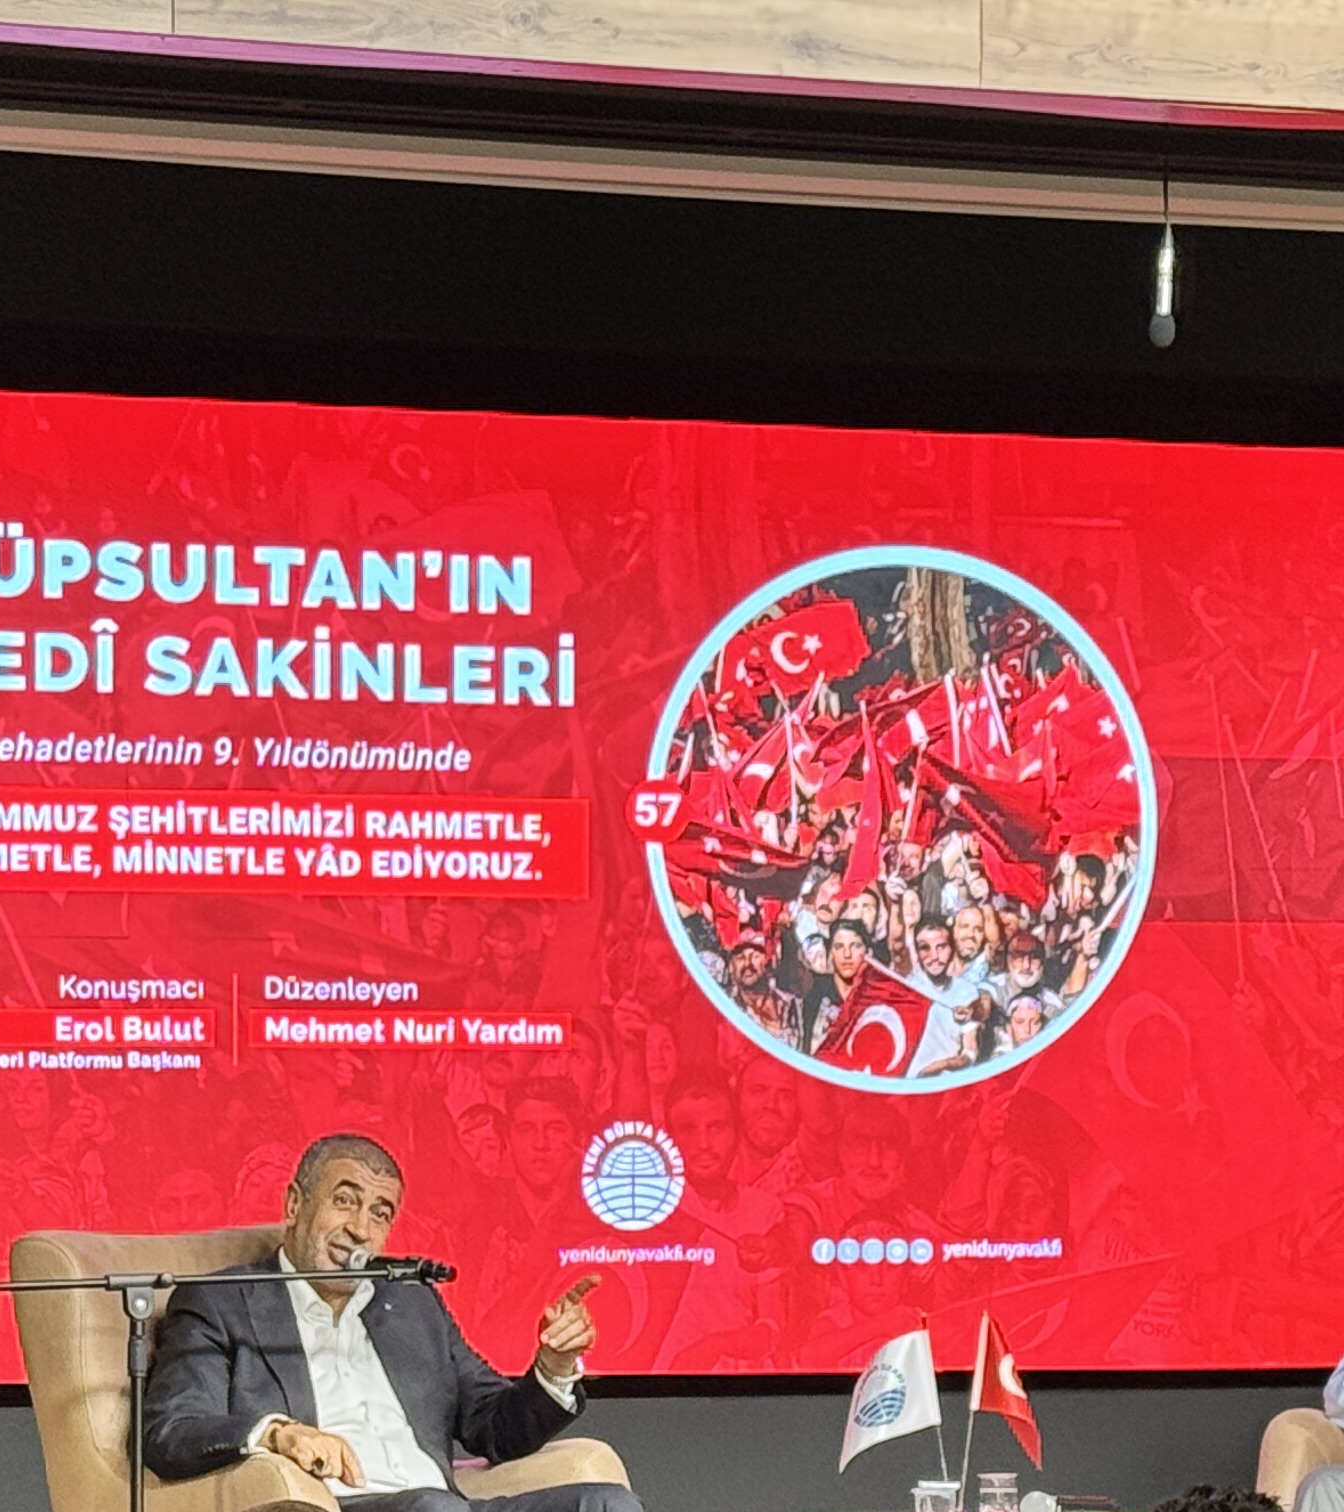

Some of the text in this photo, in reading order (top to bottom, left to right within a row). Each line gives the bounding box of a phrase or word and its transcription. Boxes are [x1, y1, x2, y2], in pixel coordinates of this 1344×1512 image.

[144, 625, 575, 707] SAKİNLERİ
[214, 737, 239, 766] 9.
[254, 737, 472, 772] Yıldönümünde
[109, 800, 354, 840] ŞEHİTLERİMİZİ
[365, 811, 551, 847] RAHMETLE,
[635, 793, 681, 828] 57
[113, 838, 285, 875] MİNNETLE
[295, 843, 362, 878] YÂD
[371, 844, 543, 880] EDİYORUZ.
[59, 975, 204, 1003] Konuşmacı
[264, 975, 419, 1007] Düzenleyen
[56, 1016, 206, 1042] Erol Bulut
[265, 1016, 563, 1044] Mehmet Nuri Yardım
[29, 1051, 123, 1070] Platformu
[127, 1052, 201, 1072] Başkanı
[558, 1244, 716, 1268] yenidunyavakfi.org
